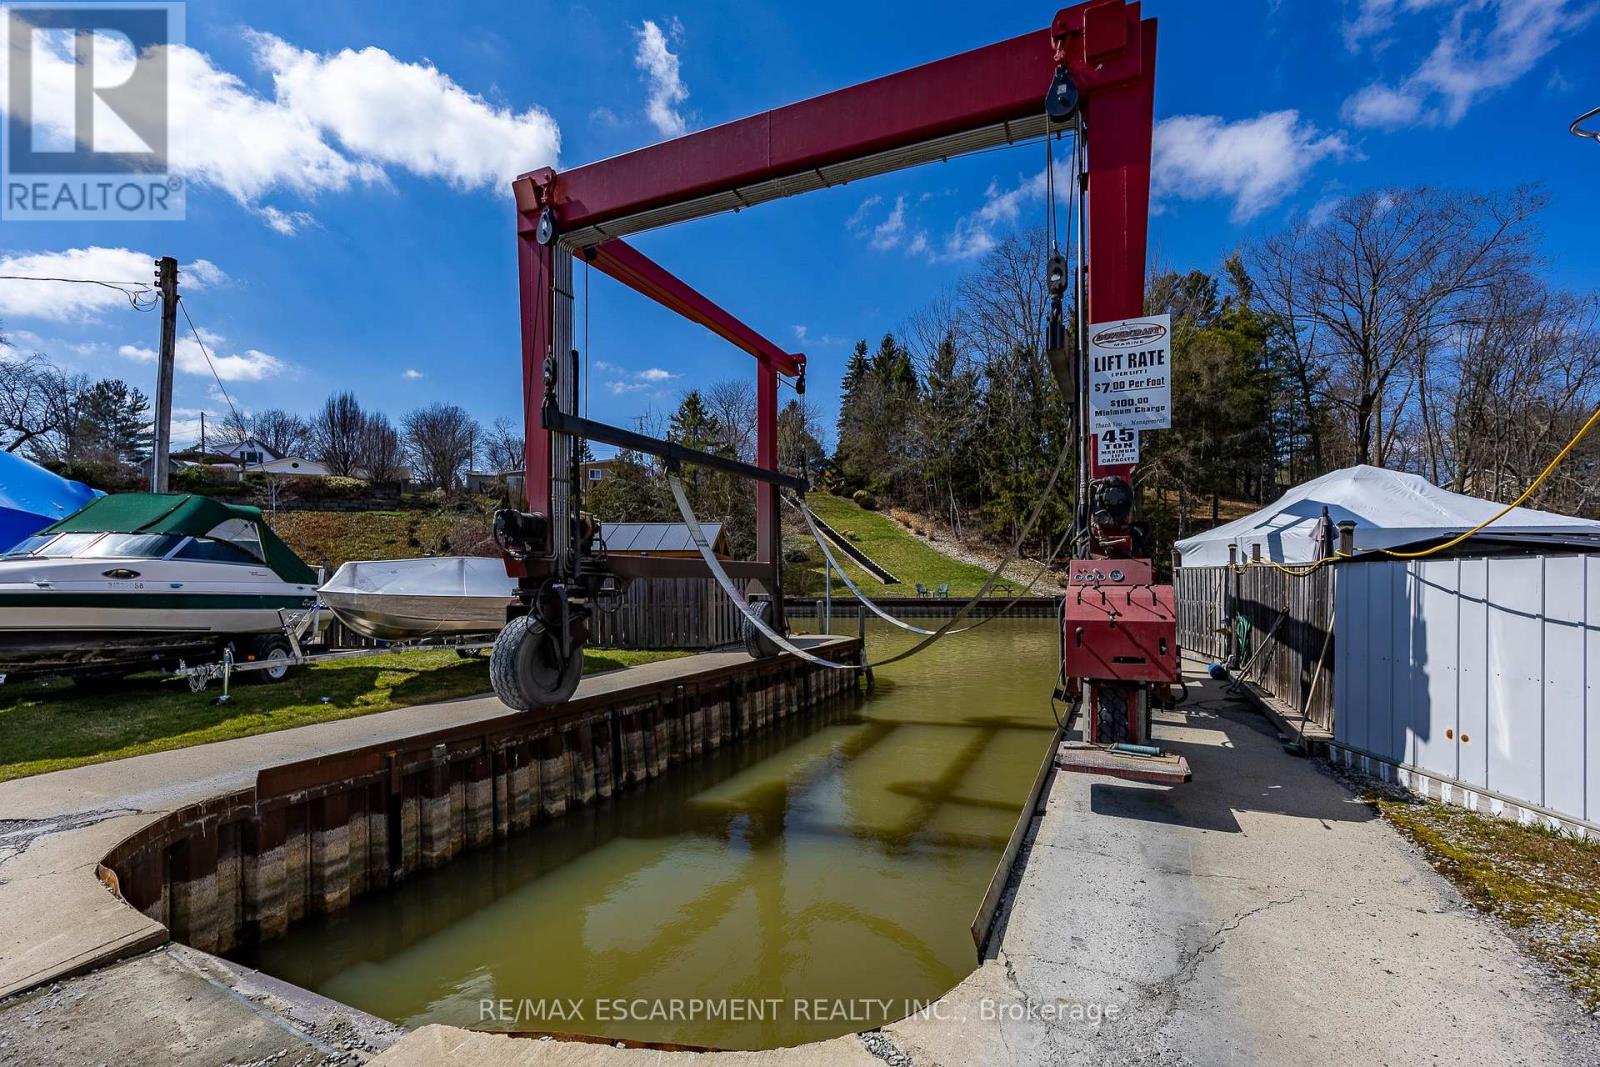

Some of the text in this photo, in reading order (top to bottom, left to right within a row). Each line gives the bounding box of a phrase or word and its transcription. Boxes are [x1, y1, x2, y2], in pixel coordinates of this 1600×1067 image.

[1094, 349, 1165, 372] LIFT RATE
[1094, 377, 1165, 394] $7.00 Per Foot
[1110, 397, 1149, 407] $100.00
[1094, 405, 1165, 416] Minimum Charge
[1102, 428, 1135, 443] 45
[1104, 442, 1133, 450] TON
